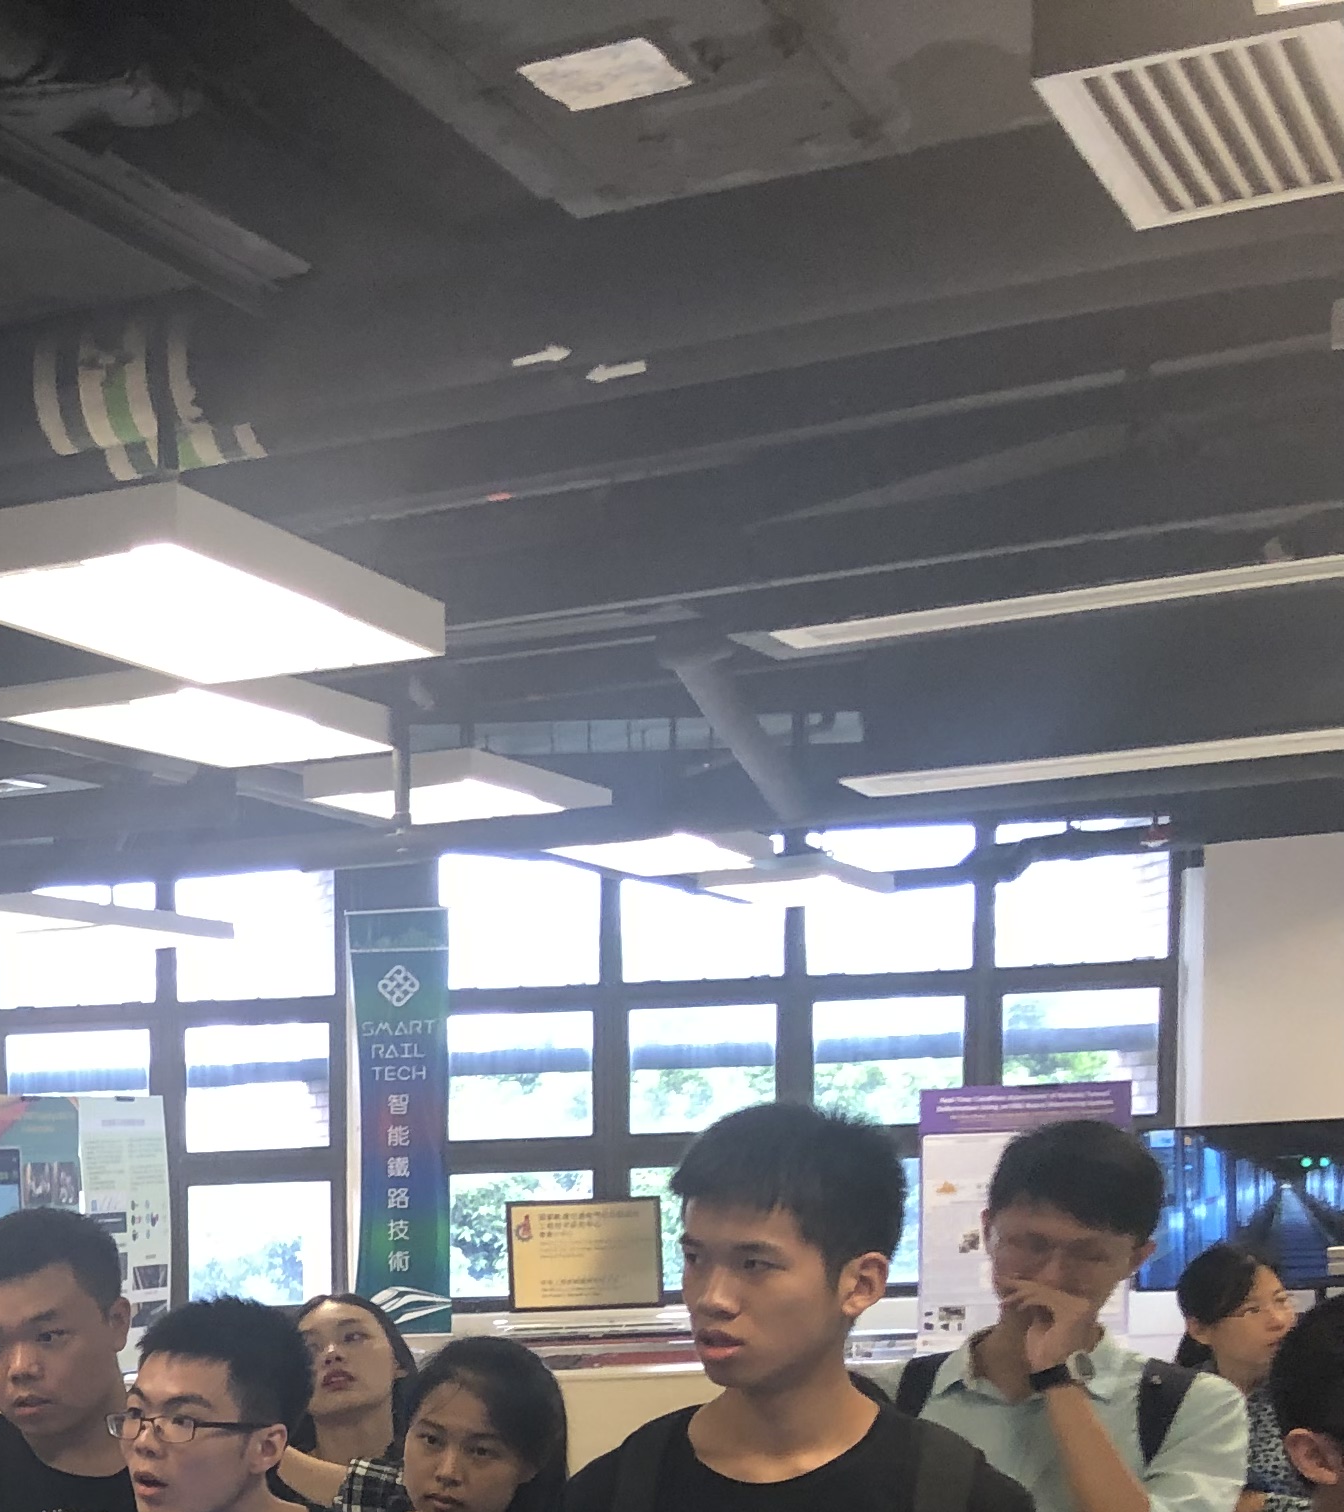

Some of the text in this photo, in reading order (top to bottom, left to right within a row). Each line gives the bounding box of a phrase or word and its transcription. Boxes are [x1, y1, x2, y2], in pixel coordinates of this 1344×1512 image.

[361, 1020, 435, 1036] SMART
[371, 1043, 426, 1059] RAIL
[371, 1065, 426, 1081] TECH
[386, 1093, 411, 1272] 智能鐵路技術
